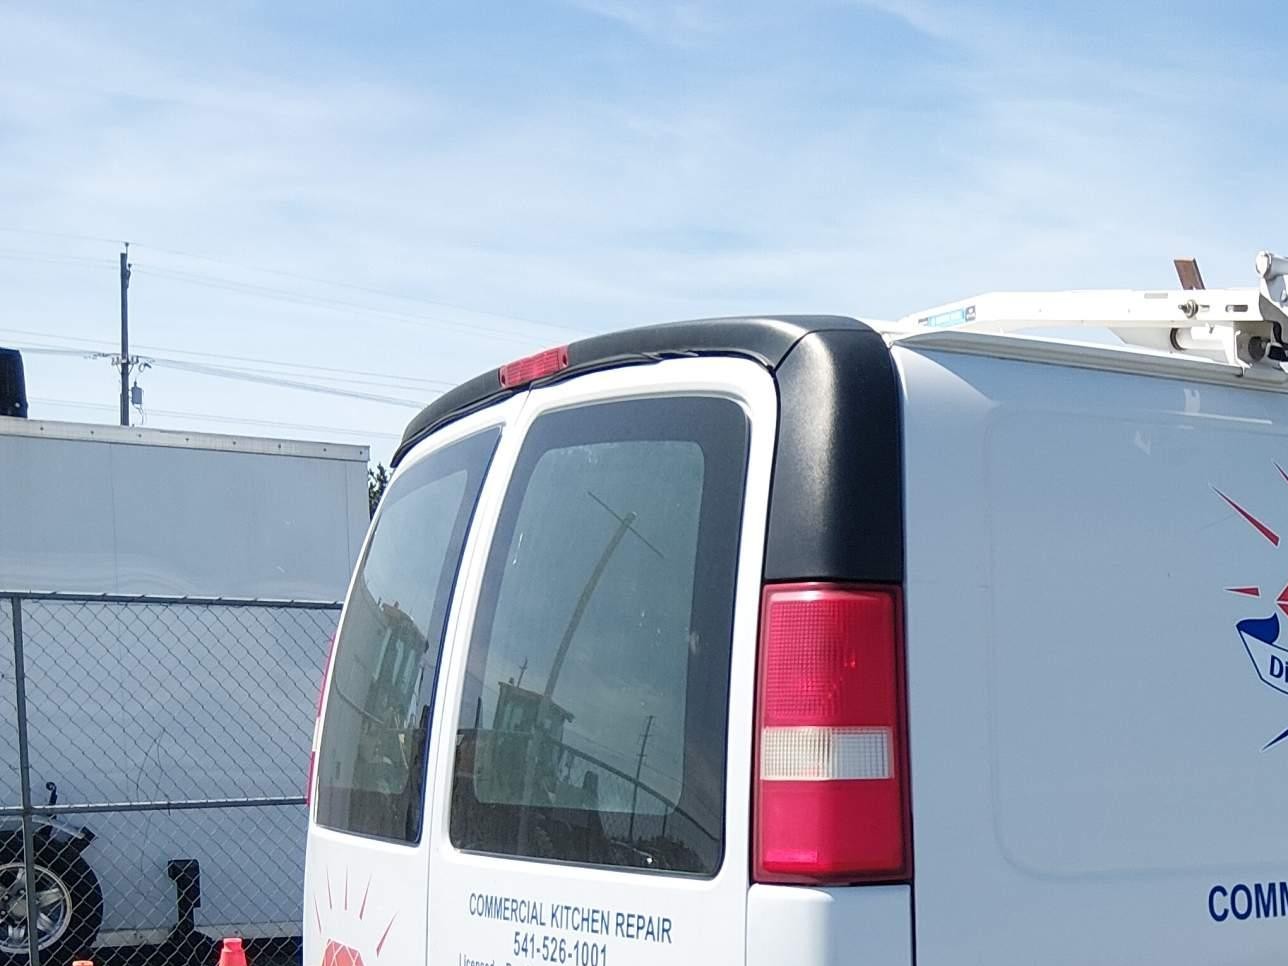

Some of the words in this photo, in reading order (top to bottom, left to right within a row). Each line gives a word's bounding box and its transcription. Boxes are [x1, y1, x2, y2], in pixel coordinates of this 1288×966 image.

[469, 892, 546, 927] COMMERCIAL
[551, 903, 610, 935] KITCHEN
[615, 912, 673, 944] REPAIR
